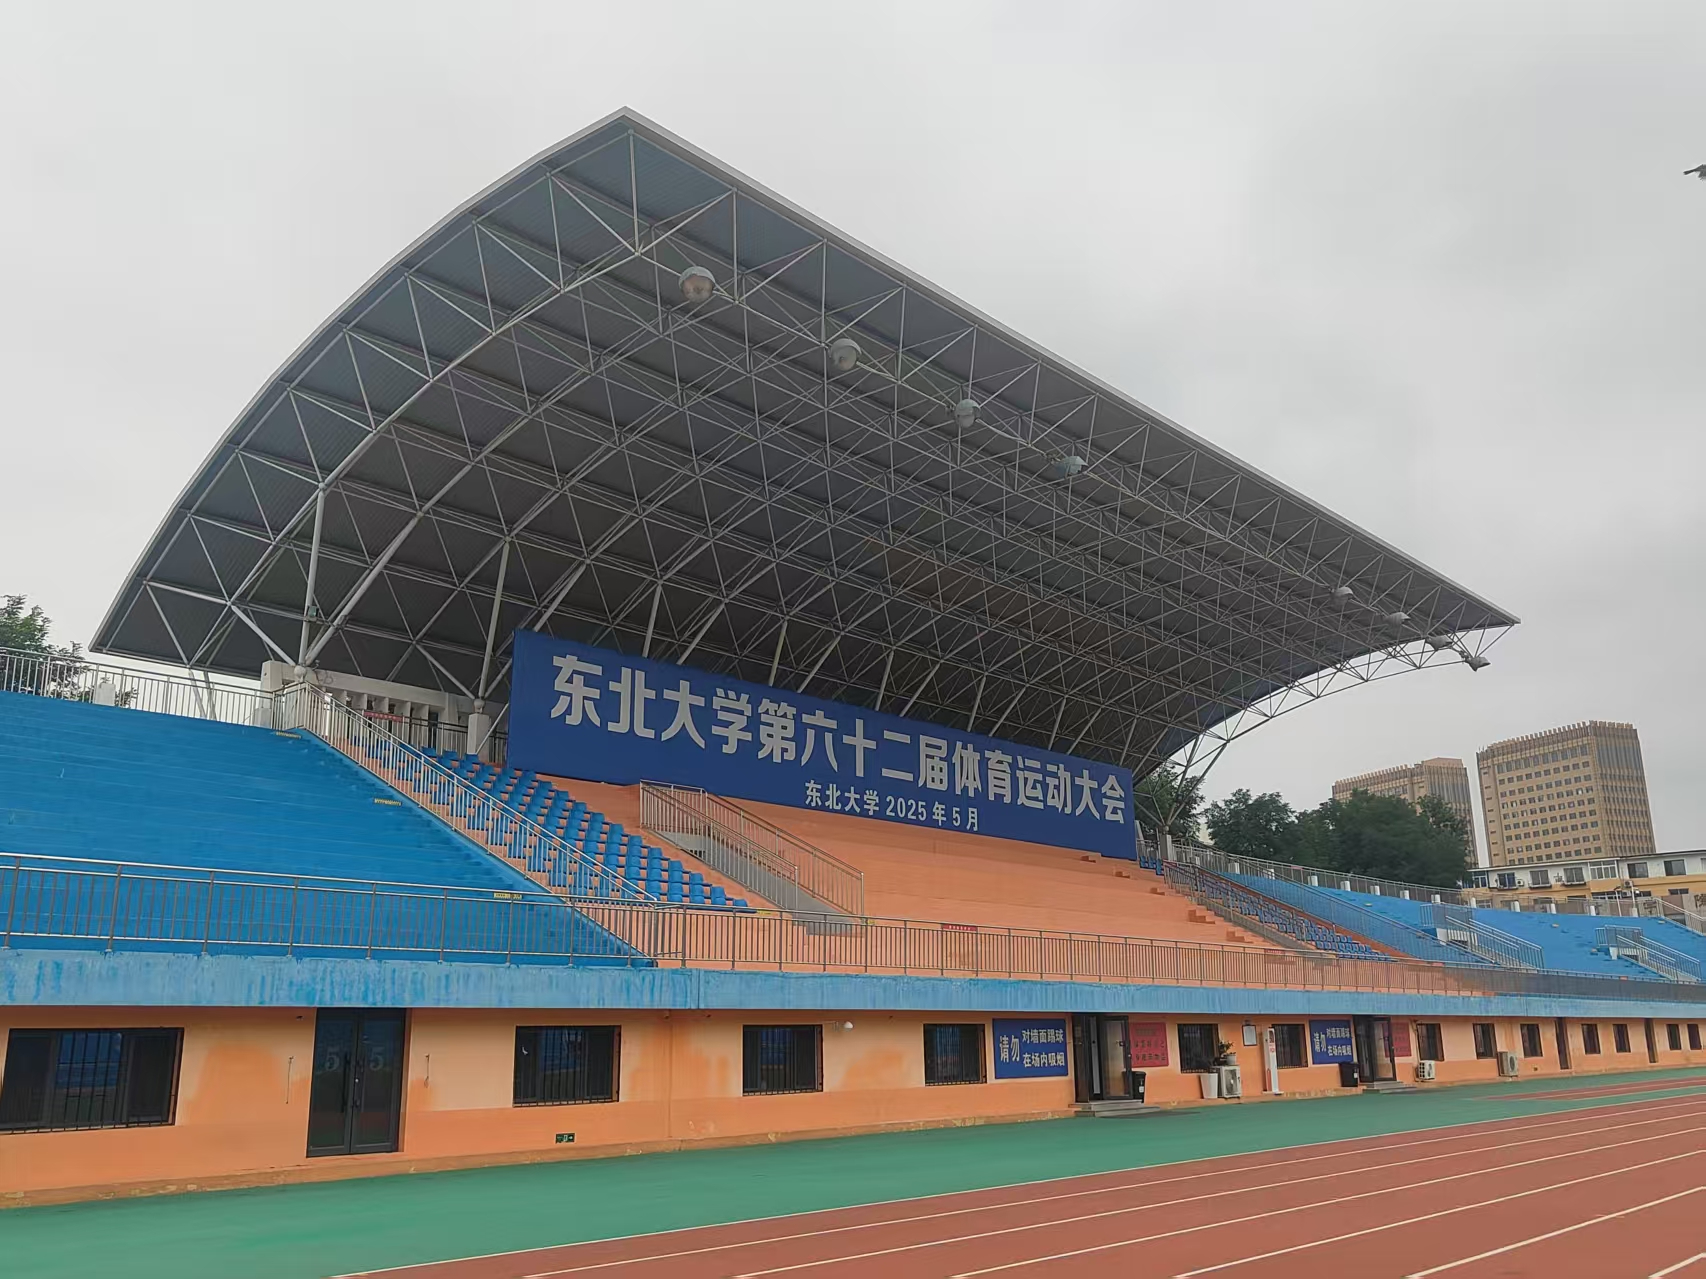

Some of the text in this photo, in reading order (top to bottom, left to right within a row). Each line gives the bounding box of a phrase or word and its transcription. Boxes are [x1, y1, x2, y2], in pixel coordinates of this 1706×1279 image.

[551, 655, 1124, 823] 东北大学第六十二届体育运动大会
[1022, 1029, 1064, 1044] 对墙面踢球
[999, 1035, 1020, 1063] 请勿
[1023, 1052, 1065, 1067] 在场内吸烟
